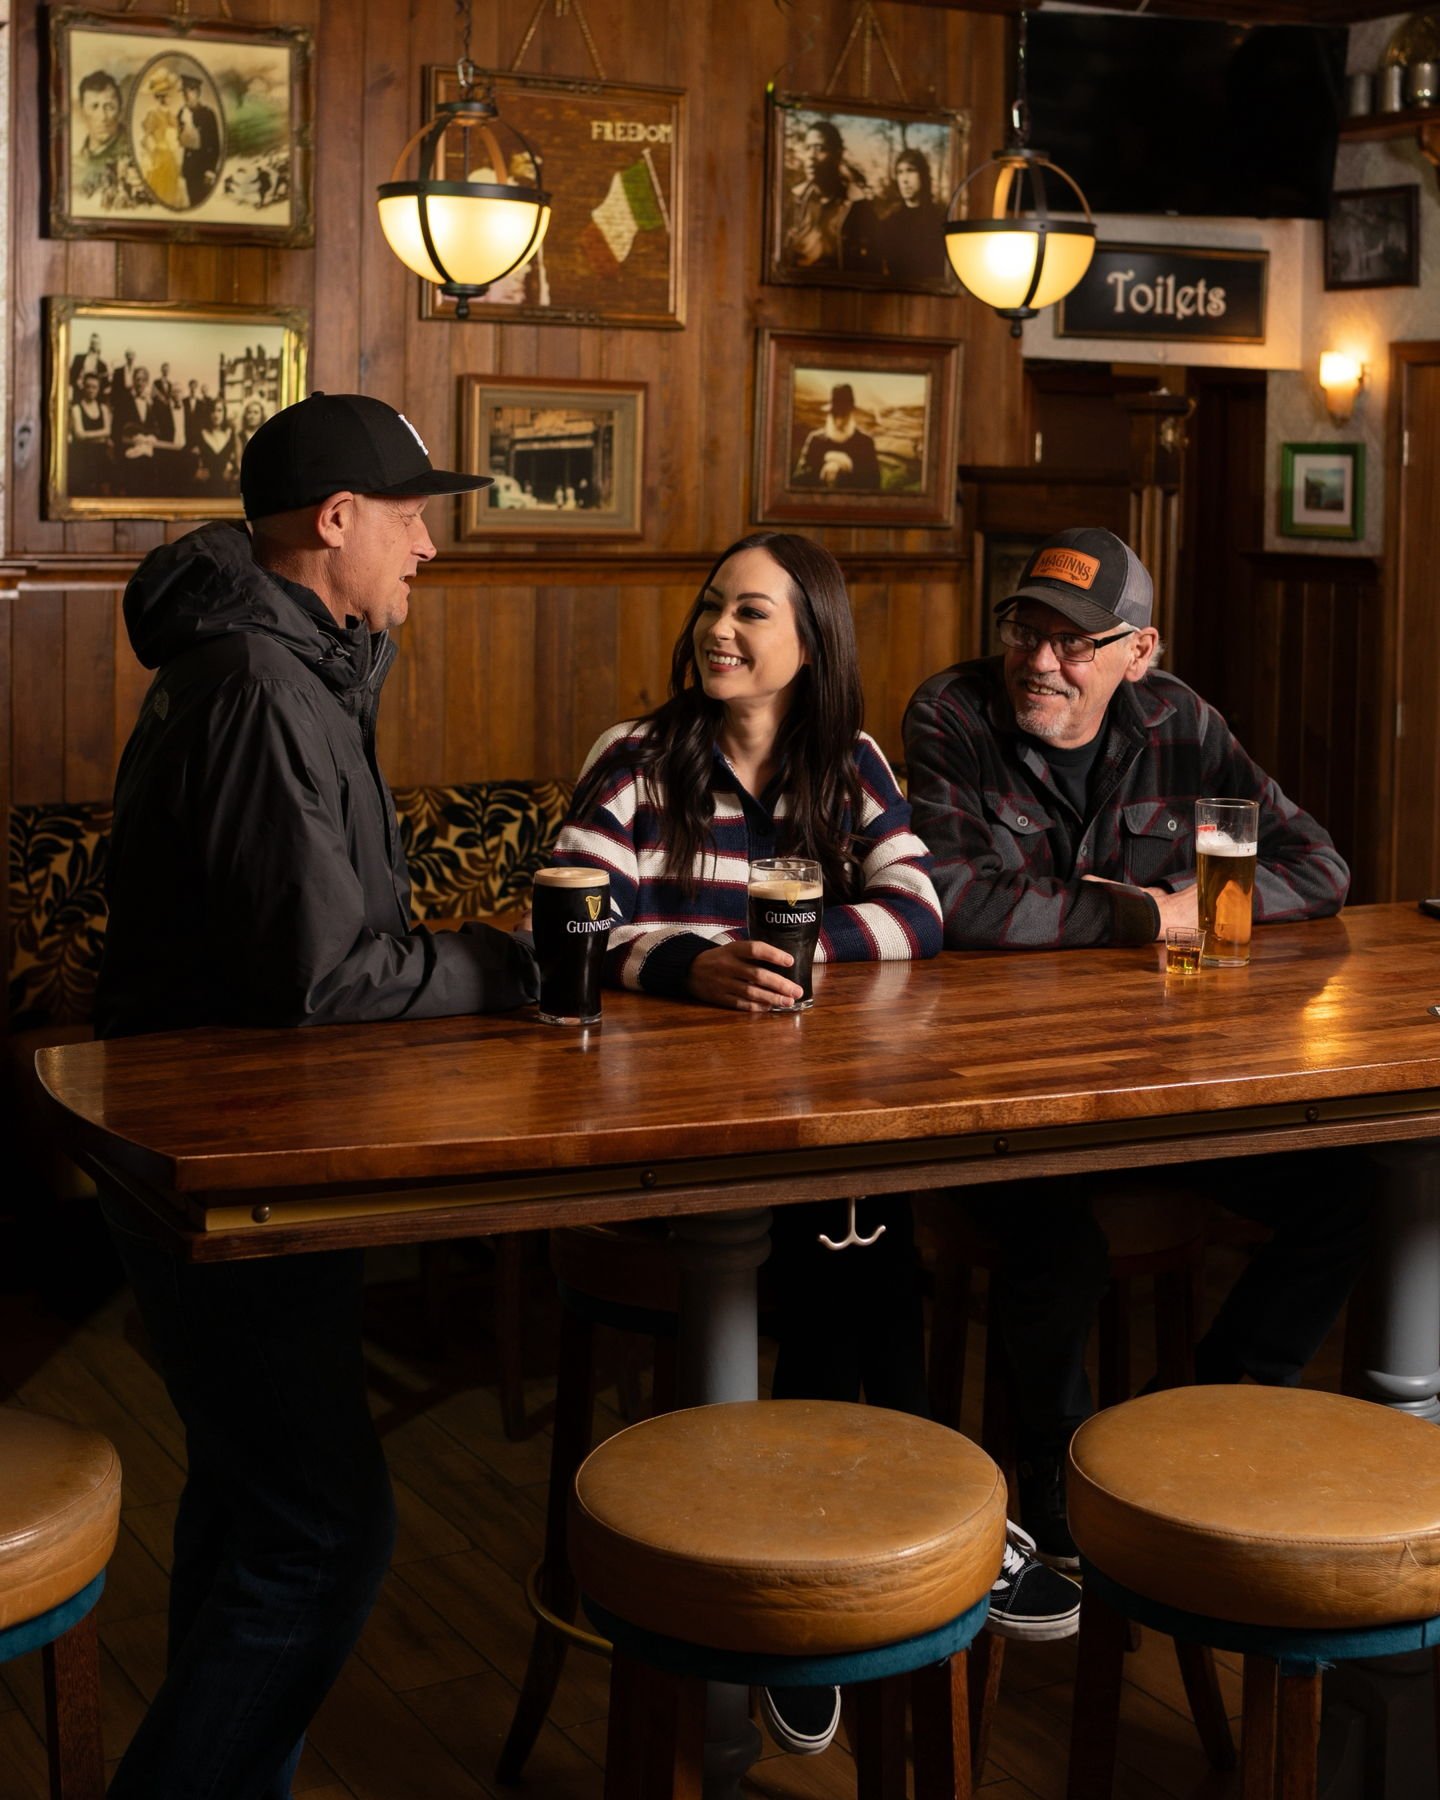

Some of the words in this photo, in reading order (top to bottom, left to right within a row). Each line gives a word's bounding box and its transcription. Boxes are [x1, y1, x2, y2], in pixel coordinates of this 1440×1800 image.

[591, 121, 673, 143] FREEDOM
[1107, 269, 1226, 320] Toilets
[1039, 553, 1091, 581] MAGINNS
[765, 910, 816, 924] GUINNESS
